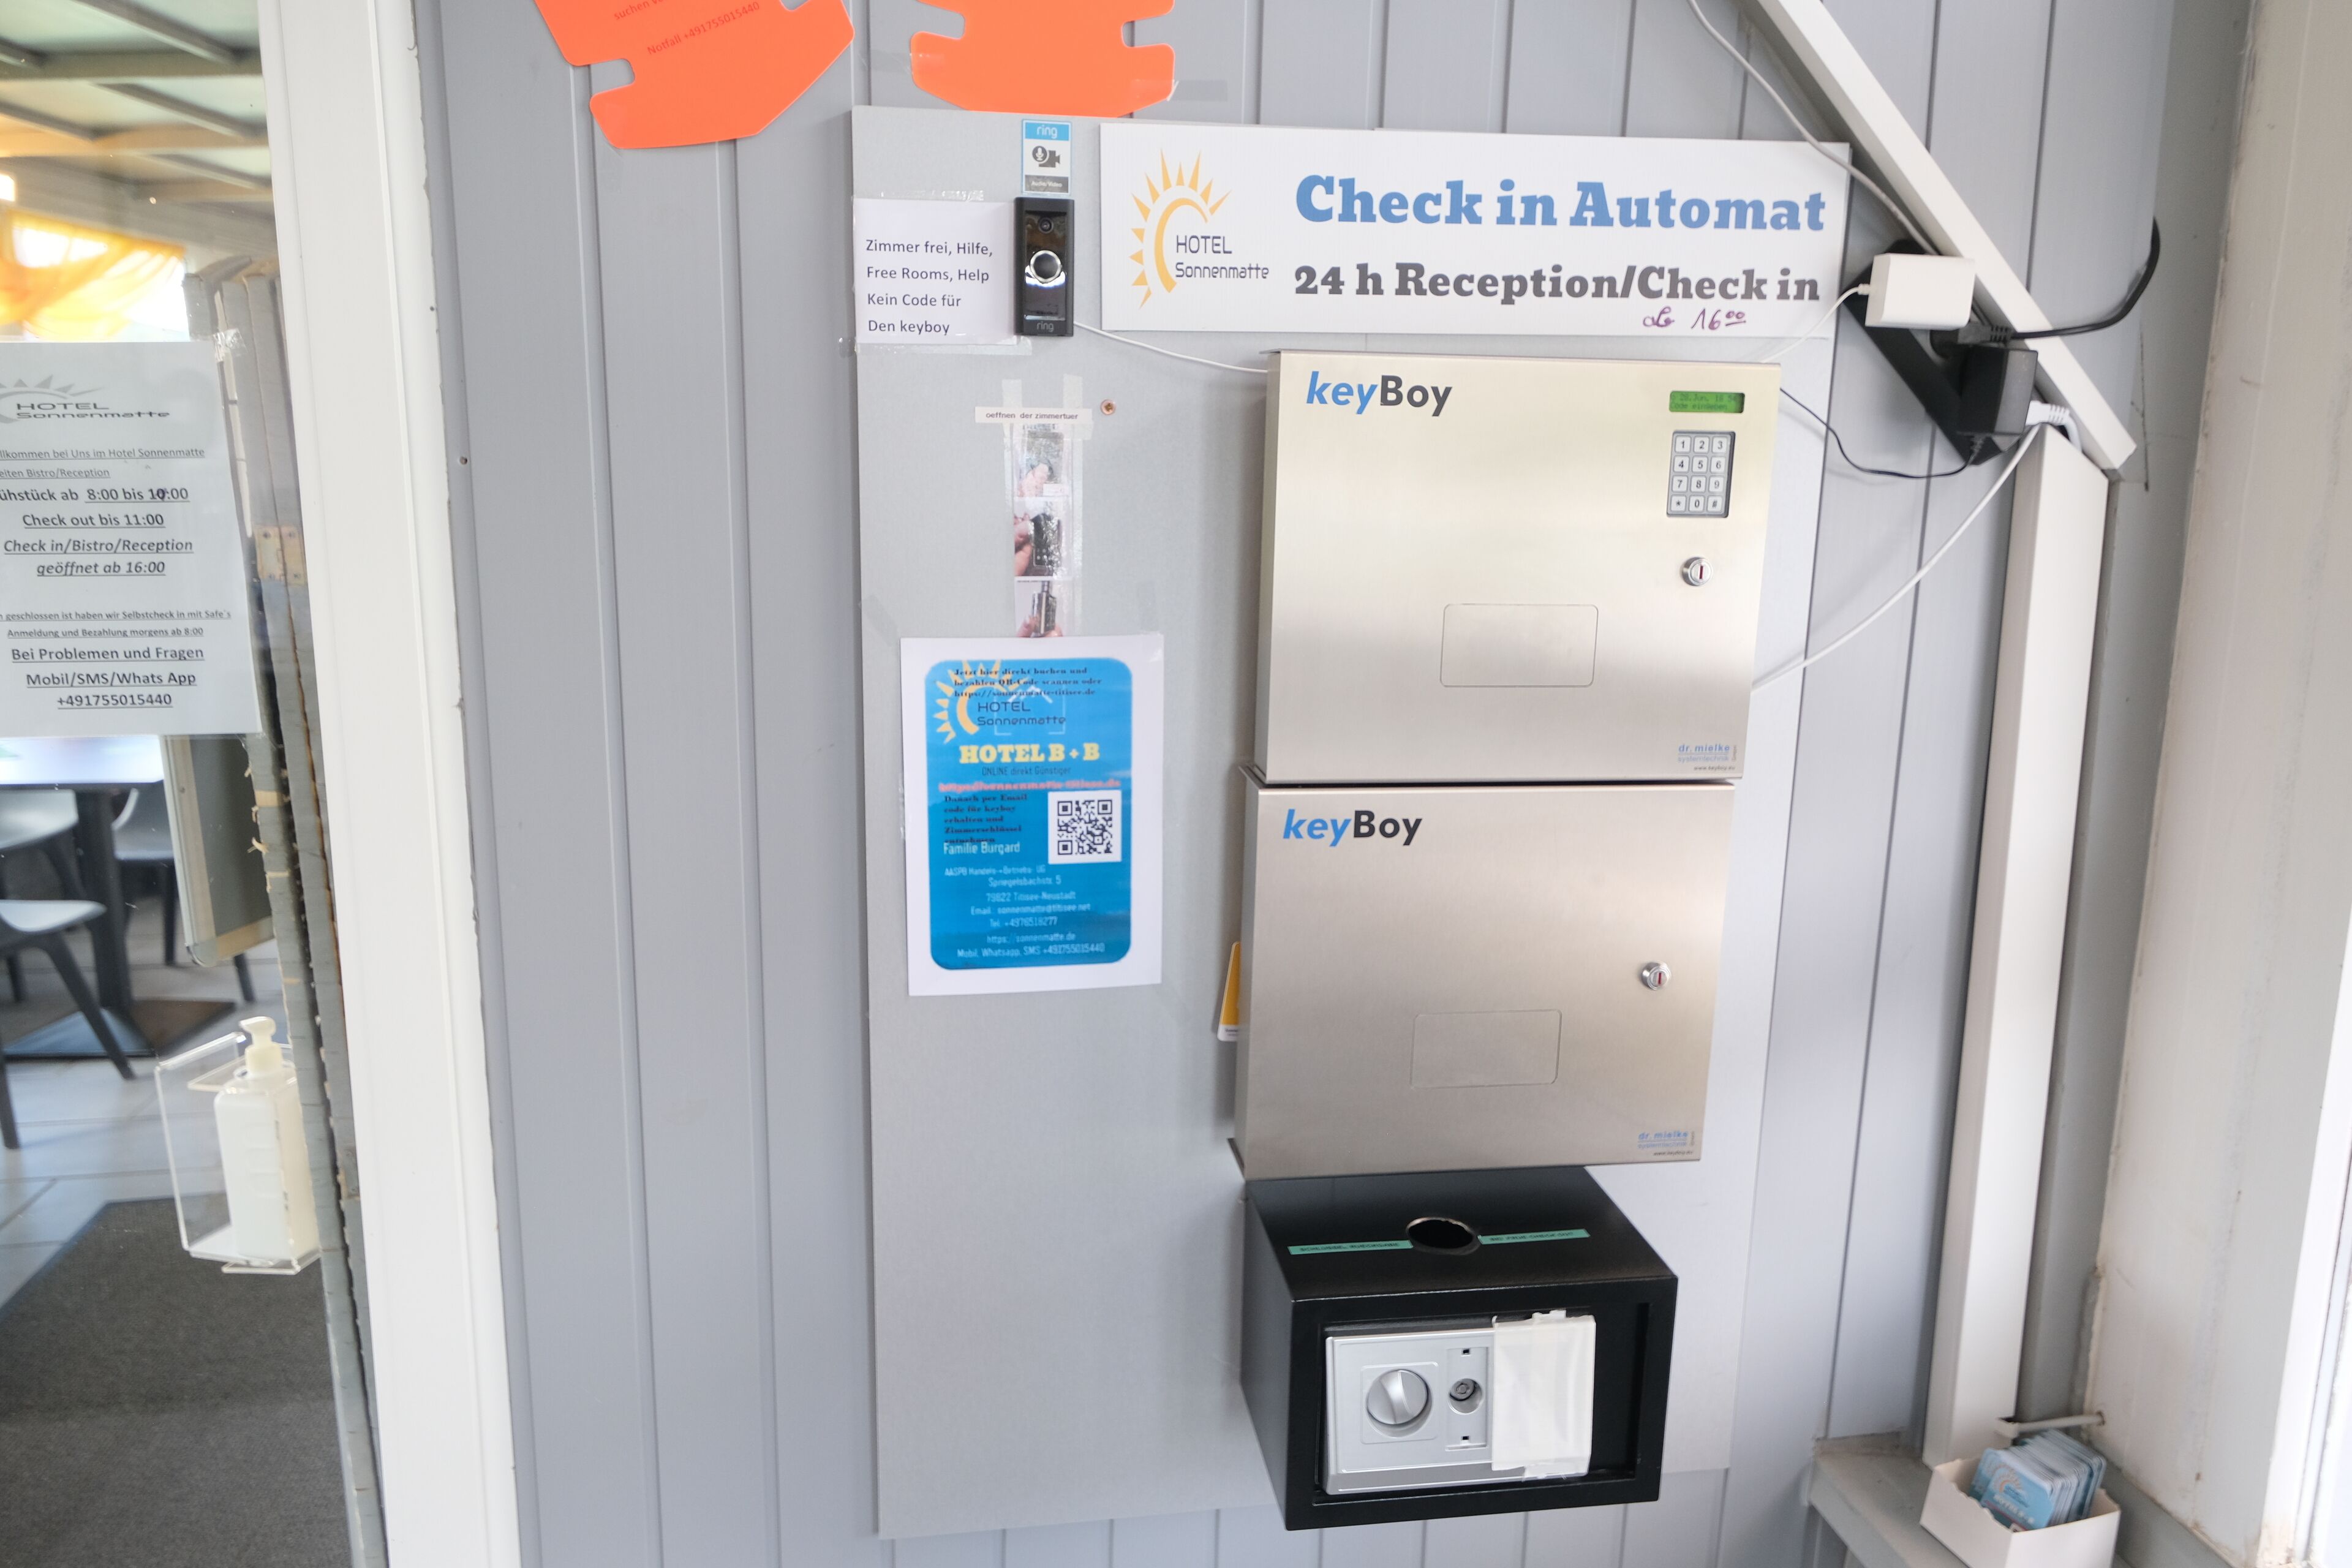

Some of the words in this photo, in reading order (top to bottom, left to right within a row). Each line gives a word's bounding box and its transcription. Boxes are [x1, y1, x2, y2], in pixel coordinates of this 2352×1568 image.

[614, 1, 650, 20] suchen
[647, 34, 682, 55] Notfall
[684, 1, 760, 39] +491755015440
[1037, 124, 1058, 139] ring
[1296, 175, 1482, 224] Check
[1496, 179, 1557, 225] in
[1570, 181, 1825, 232] Automat
[866, 239, 919, 252] Zimmer
[924, 241, 952, 256] frei,
[957, 243, 993, 257] Hilfe,
[1176, 235, 1232, 254] HOTEL
[867, 267, 897, 278] Free
[902, 268, 953, 282] Rooms,
[958, 269, 989, 283] Help
[1175, 262, 1269, 279] Sonnenmatte
[1295, 265, 1344, 295] 24
[1356, 263, 1384, 295] h
[1395, 263, 1768, 305] Reception/Check
[1777, 268, 1819, 301] in
[867, 293, 897, 305] Kein
[902, 294, 937, 306] Code
[941, 294, 962, 306] für
[869, 320, 895, 332] Den
[900, 320, 950, 335] keyboy
[1036, 322, 1054, 333] ring
[1306, 371, 1452, 417] keyBoy
[1699, 440, 1705, 449] 2
[1717, 441, 1723, 450] 3
[53, 450, 68, 458] bei
[72, 450, 91, 458] Uns
[93, 449, 106, 458] im
[108, 448, 136, 458] Hotel
[138, 448, 205, 458] Sonnenmatte
[1698, 461, 1703, 469] 5
[27, 467, 110, 478] Bistro/Reception
[1677, 480, 1683, 488] 7
[1696, 480, 1702, 489] 8
[1714, 480, 1719, 489] 9
[61, 488, 78, 501] ab
[88, 489, 118, 500] 8:00
[123, 488, 144, 500] bis
[1694, 499, 1700, 508] 0
[22, 514, 67, 526] Check
[70, 516, 94, 526] out
[99, 514, 120, 526] bis
[125, 514, 164, 526] 11:00
[4, 540, 46, 552] Check
[51, 538, 193, 553] in/Bistro/Reception
[37, 562, 99, 576] geöffnet
[104, 562, 121, 574] ab
[126, 561, 165, 574] 16:00
[6, 612, 59, 621] geschlossen
[75, 611, 103, 620] haben
[123, 611, 175, 619] Selbstcheck
[187, 610, 202, 619] mit
[8, 629, 59, 638] Anmeldung
[62, 629, 79, 638] und
[81, 628, 128, 638] Bezahlung
[130, 628, 168, 637] morgens
[171, 627, 182, 636] ab
[184, 627, 203, 636] 8:00
[12, 649, 34, 660] Bei
[39, 648, 119, 660] Problemen
[124, 647, 150, 659] und
[156, 647, 204, 660] Fragen
[26, 671, 163, 686] Mobil/SMS/Whats
[168, 673, 196, 686] App
[57, 693, 172, 706] +491755015440
[978, 701, 1031, 712] HOTEL
[978, 715, 1066, 726] Sonnenmatte
[959, 744, 1044, 764] HOTEL
[1049, 743, 1065, 762] B
[1069, 748, 1079, 758] +
[1083, 743, 1100, 761] B
[982, 766, 1008, 776] ONLINE
[1011, 766, 1033, 775] direkt
[1283, 809, 1422, 846] keyBoy
[943, 842, 978, 855] Familie
[981, 841, 1020, 856] Burgard
